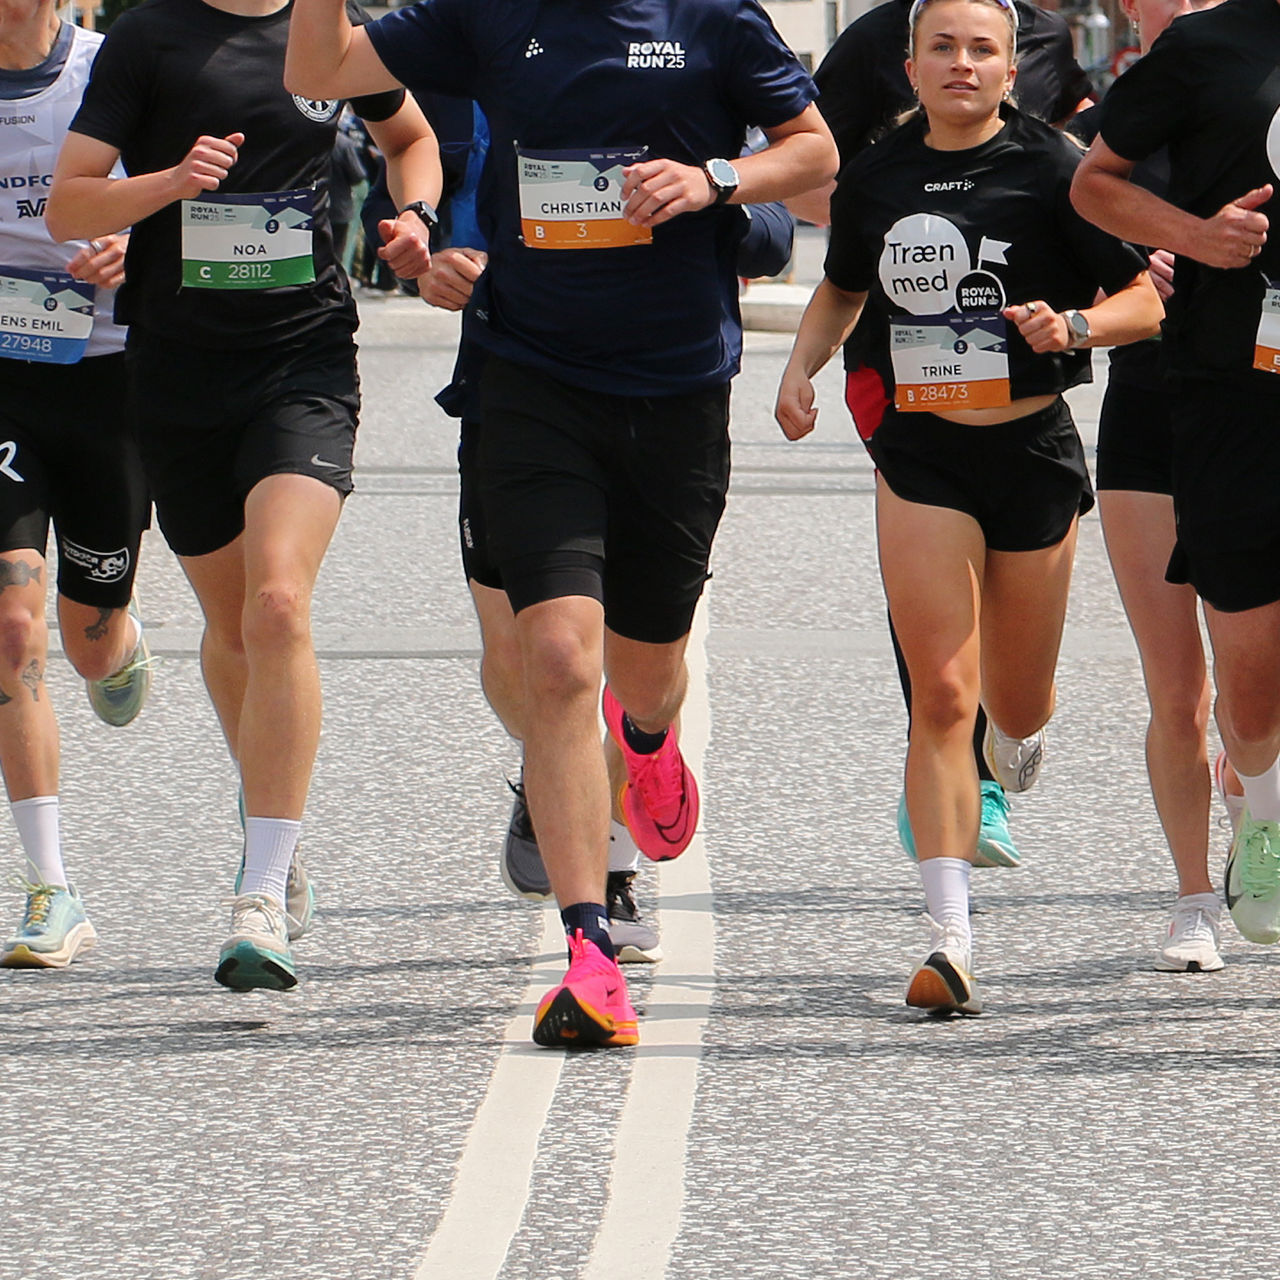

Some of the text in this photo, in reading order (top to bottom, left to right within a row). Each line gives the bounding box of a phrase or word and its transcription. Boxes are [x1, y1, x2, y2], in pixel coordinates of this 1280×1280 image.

[628, 41, 686, 54] ROYAL
[924, 182, 963, 192] CRAFT
[190, 206, 219, 214] ROYAL
[541, 201, 621, 214] CHRISTIAN
[535, 223, 588, 239] B 3
[233, 244, 267, 256] NOA
[888, 242, 954, 264] Træn
[199, 263, 272, 279] C 28112
[892, 269, 949, 295] med
[961, 287, 999, 297] ROYAL
[962, 297, 987, 307] RUN
[32, 319, 64, 332] EMIL
[1, 334, 52, 353] 27948
[921, 364, 962, 377] TRINE
[907, 384, 969, 402] B 28473
